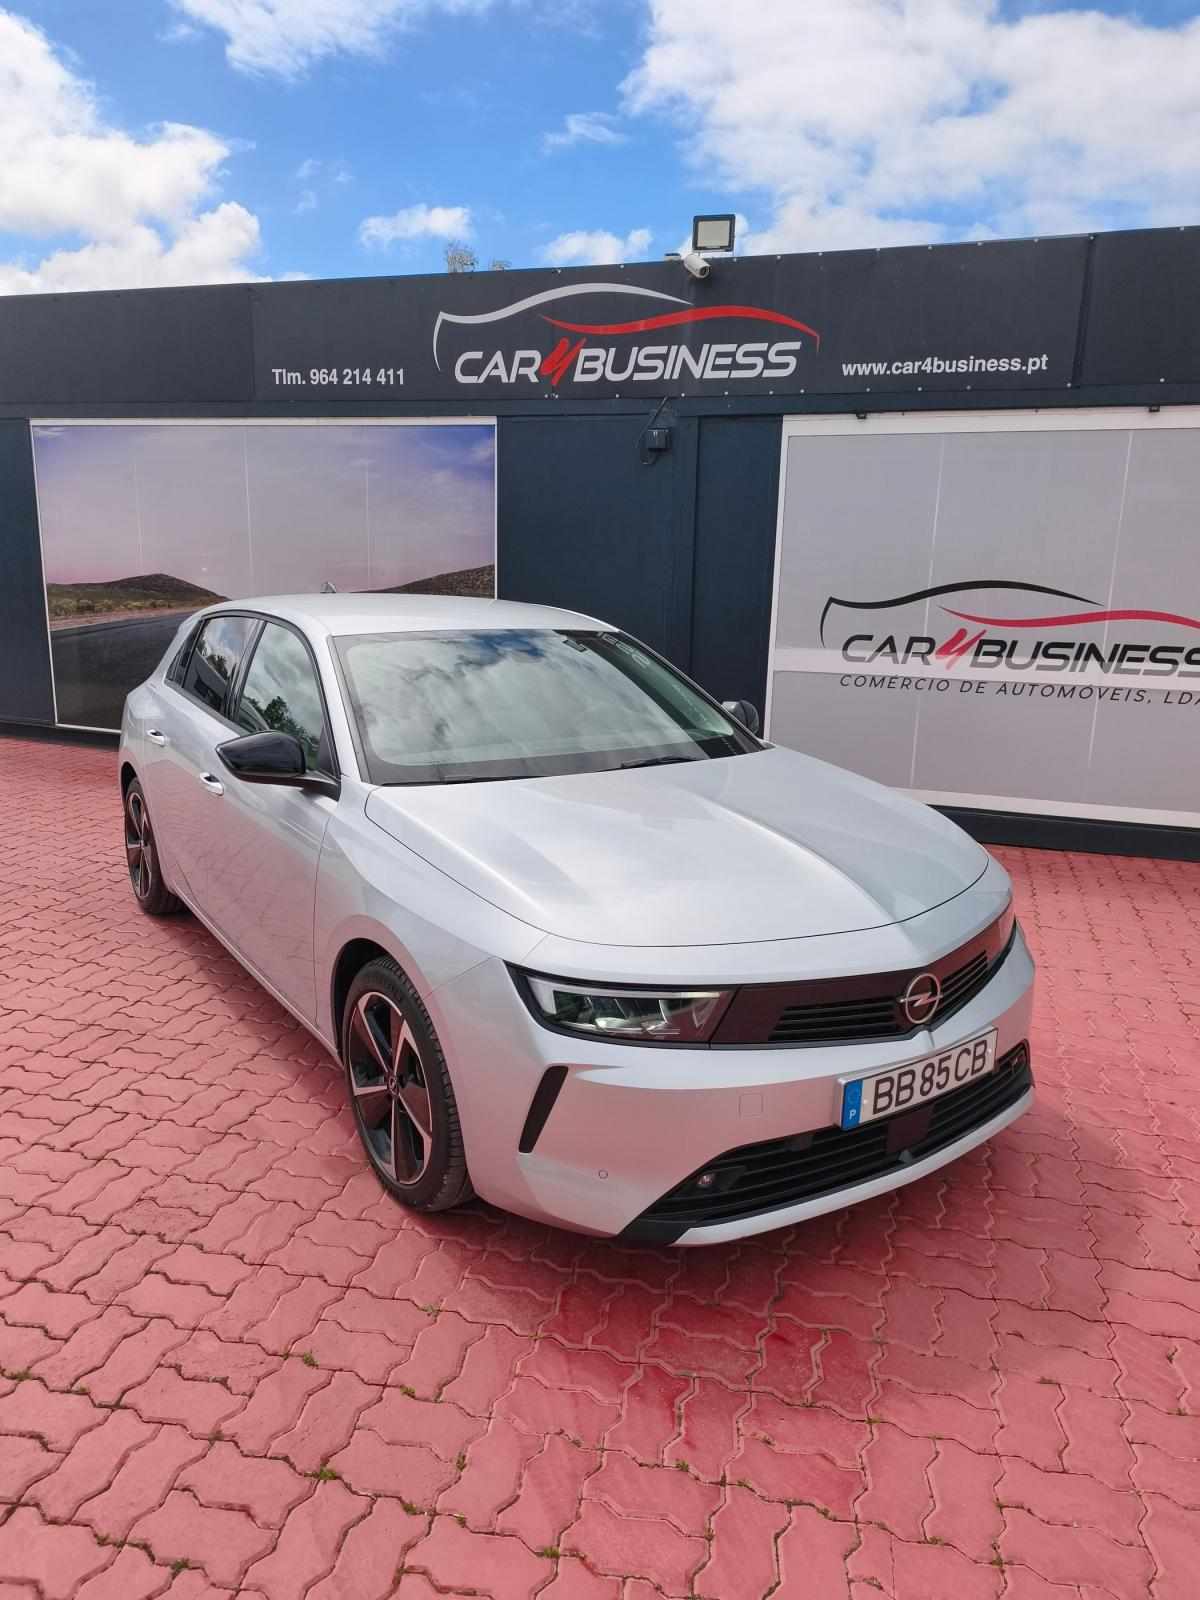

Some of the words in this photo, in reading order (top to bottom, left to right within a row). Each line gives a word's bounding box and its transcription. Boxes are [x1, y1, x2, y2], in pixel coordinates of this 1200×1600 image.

[841, 353, 1049, 377] www.car4business.pt
[271, 368, 306, 385] Tlm.
[309, 368, 339, 385] 964
[342, 368, 372, 385] 214
[376, 368, 404, 385] 411
[959, 680, 988, 694] DE
[872, 1068, 916, 1115] BB
[919, 1054, 952, 1097] 85
[954, 1039, 988, 1082] CB
